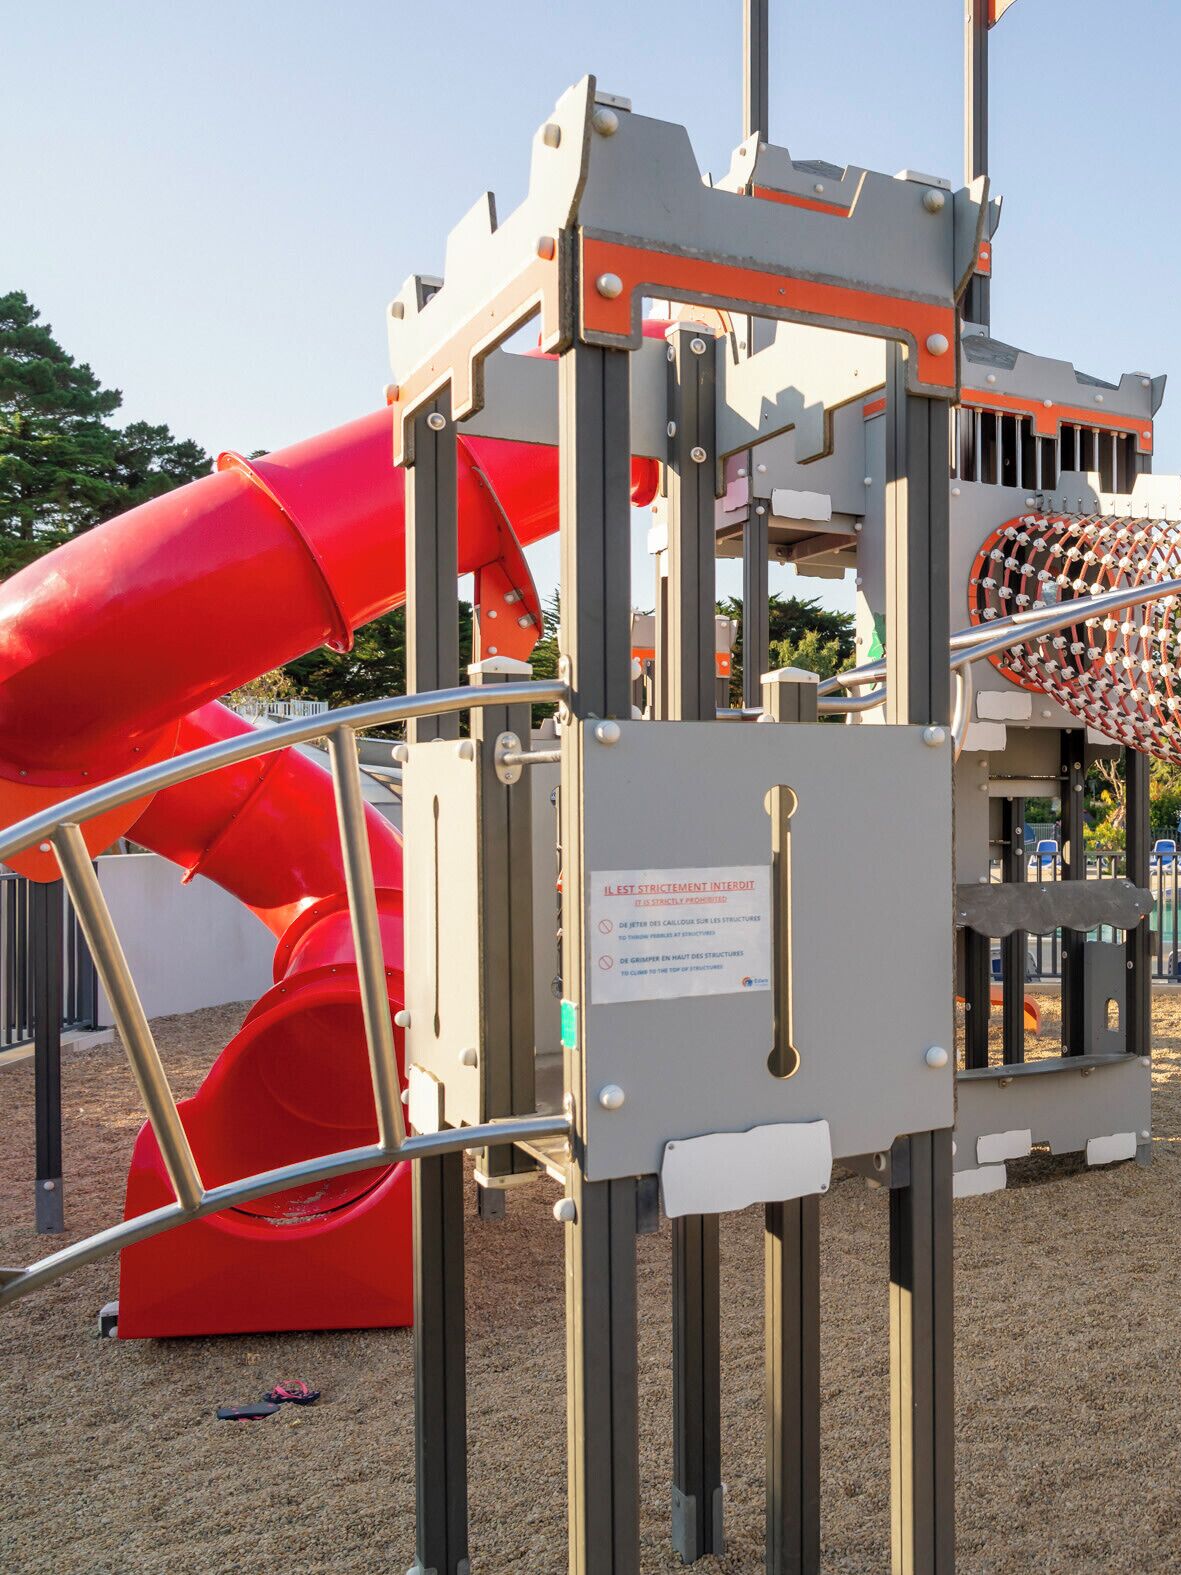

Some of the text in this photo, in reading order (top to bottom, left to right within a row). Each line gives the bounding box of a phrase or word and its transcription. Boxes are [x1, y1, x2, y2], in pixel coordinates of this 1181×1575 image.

[604, 881, 754, 895] IL EST STRICTEMENT INTERDIT
[686, 896, 727, 904] PROHIBITED
